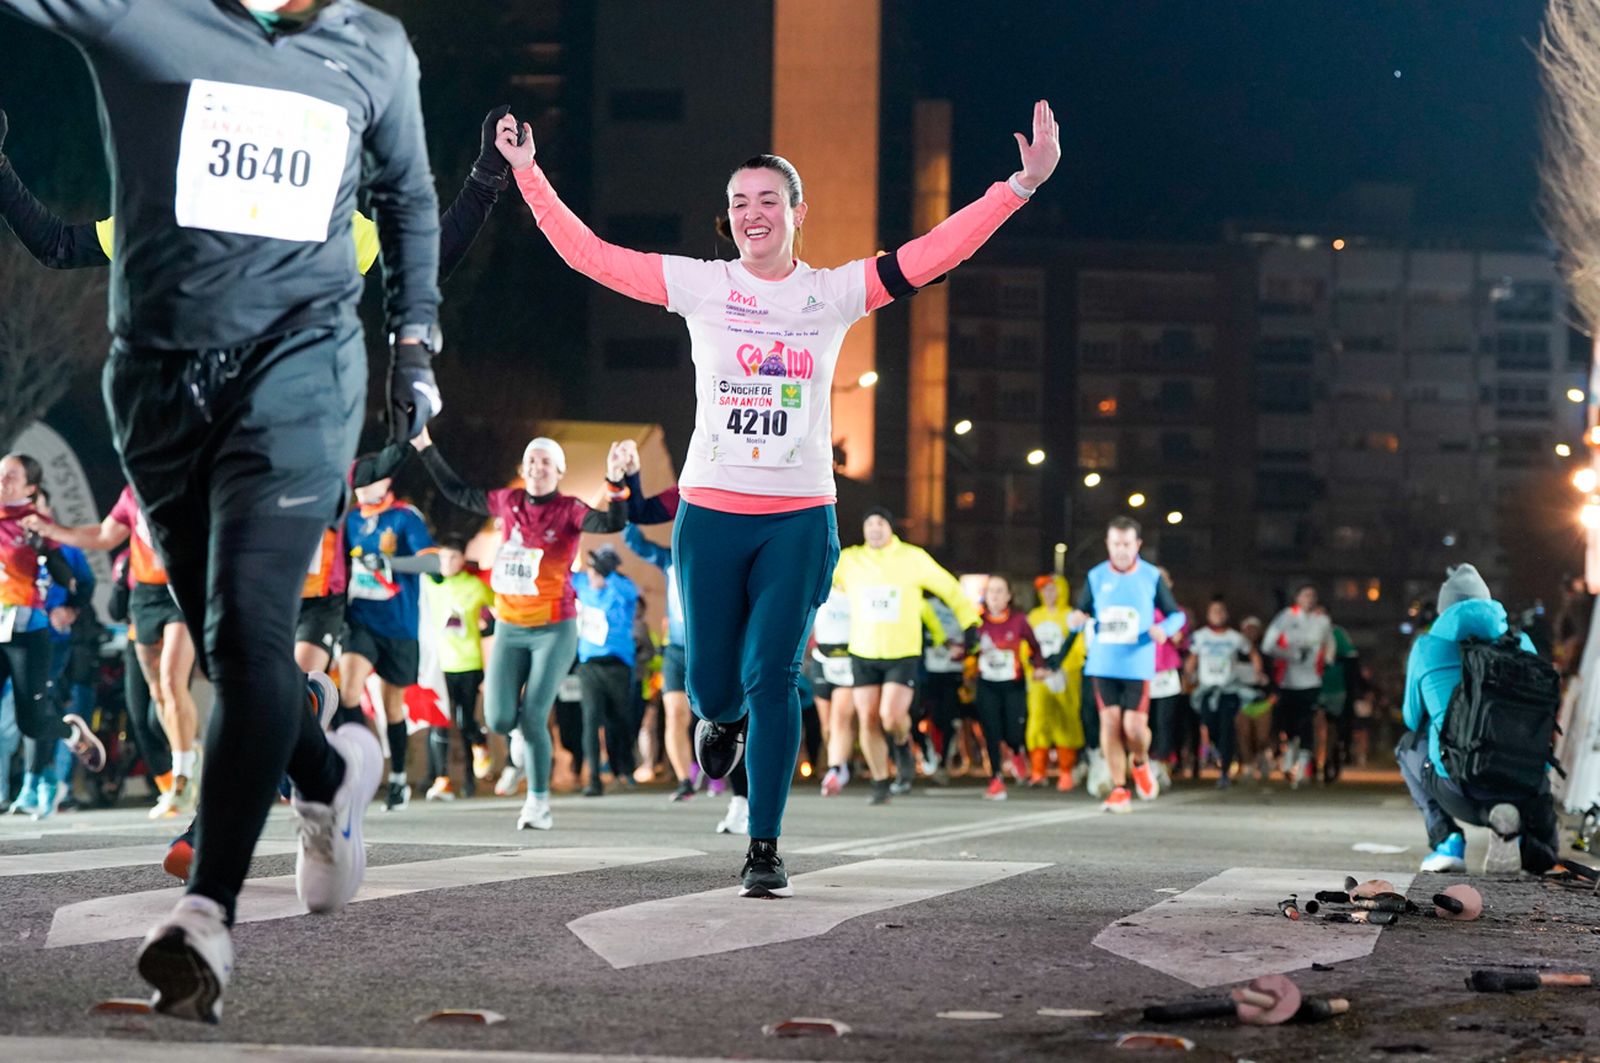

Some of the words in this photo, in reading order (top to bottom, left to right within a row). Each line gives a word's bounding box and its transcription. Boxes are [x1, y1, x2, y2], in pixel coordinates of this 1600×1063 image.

[208, 139, 311, 187] 3640
[719, 396, 738, 406] SAN
[740, 395, 773, 407] ANTÓN
[731, 386, 760, 396] NOCHE
[761, 387, 773, 396] DE
[726, 408, 788, 437] 4210
